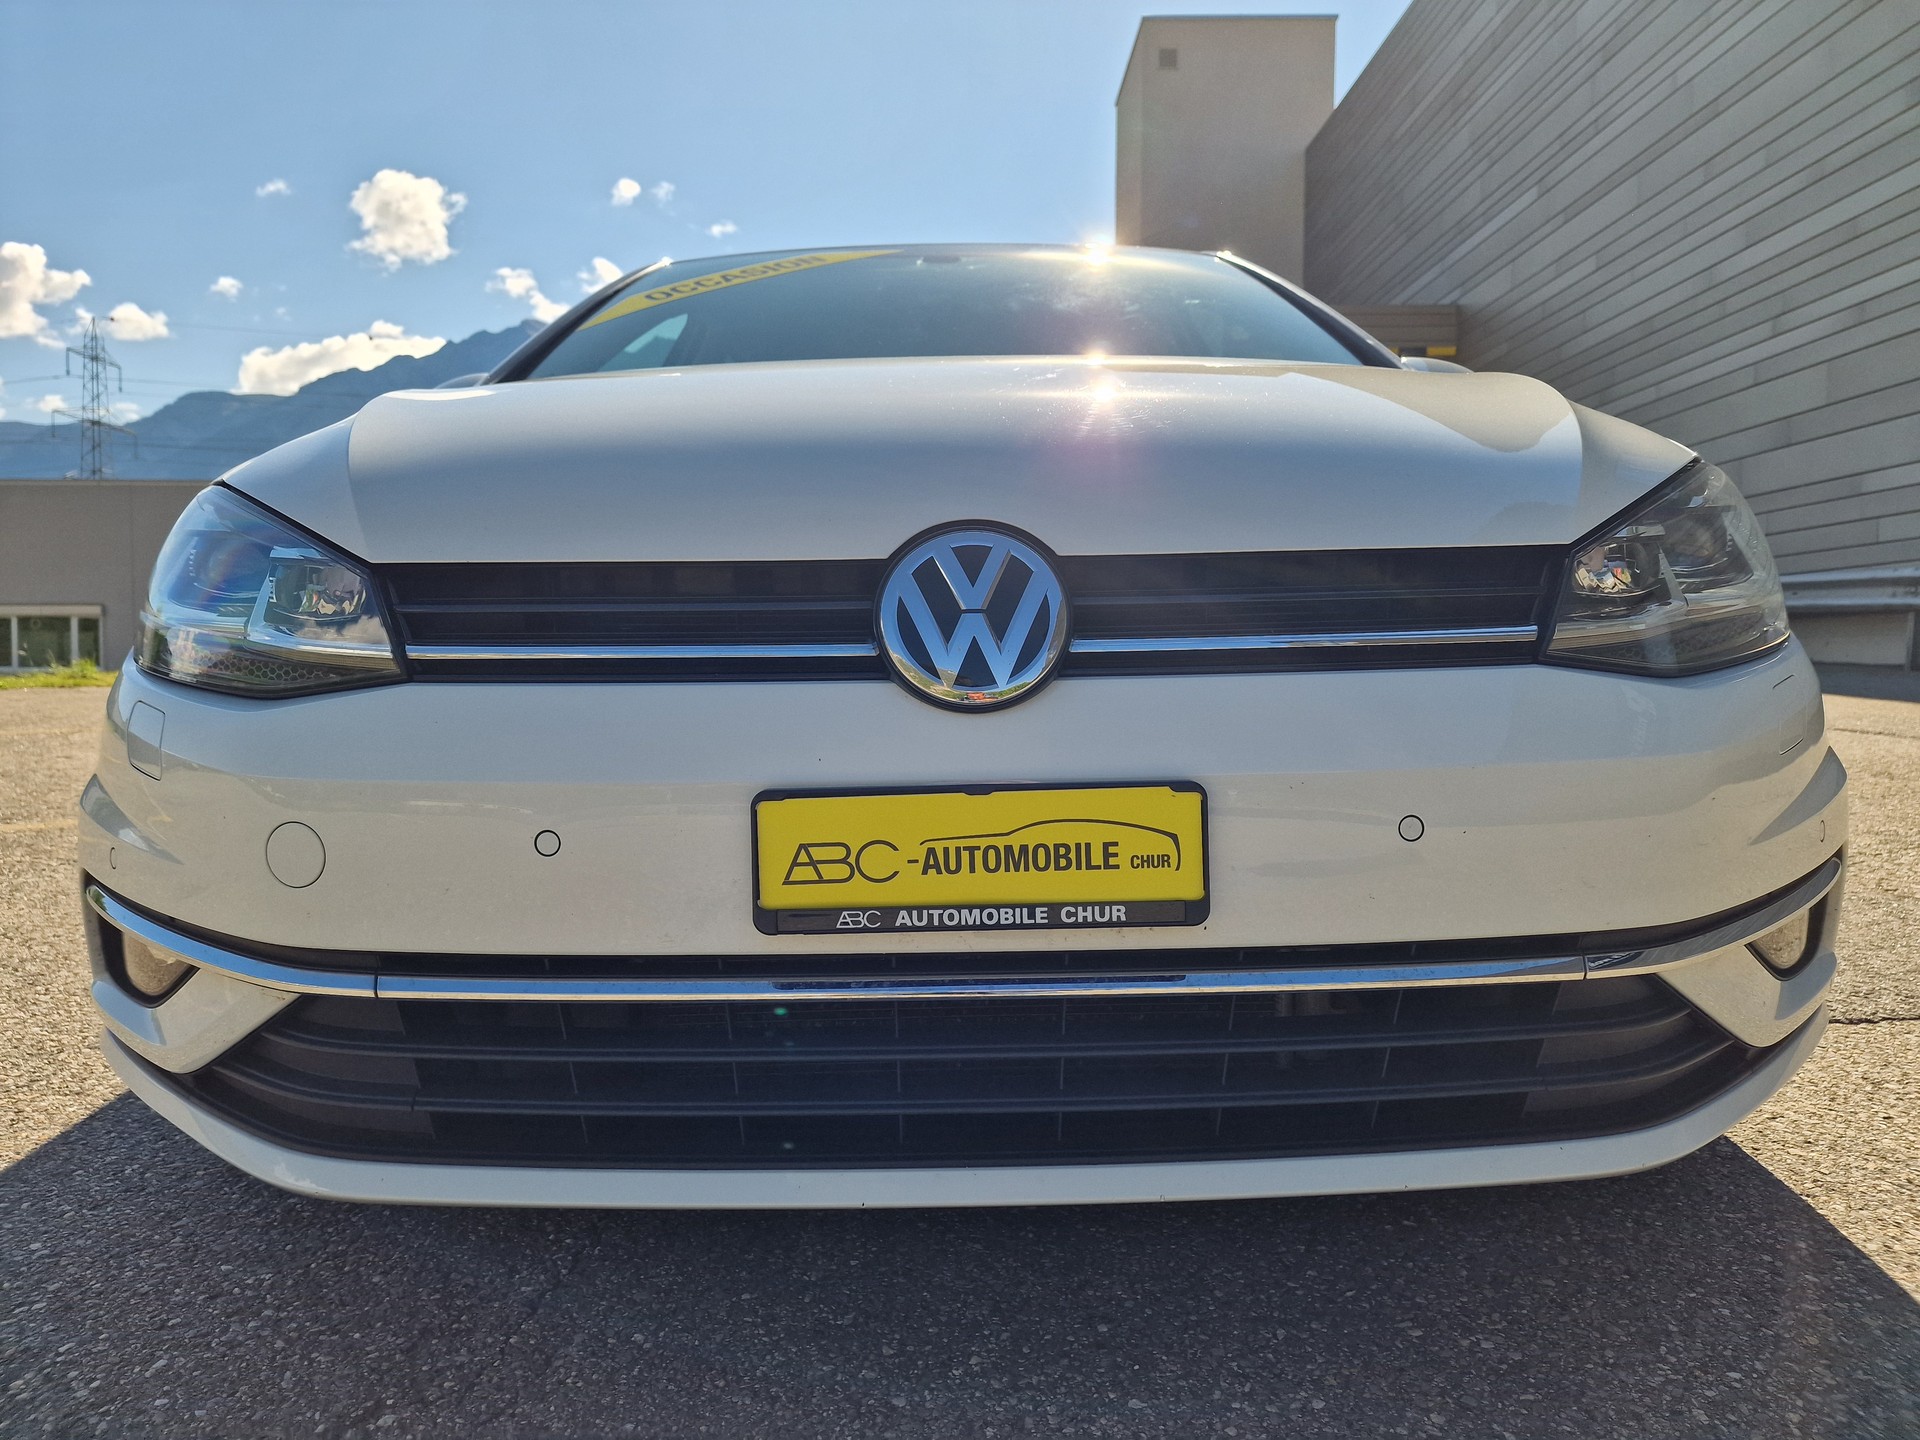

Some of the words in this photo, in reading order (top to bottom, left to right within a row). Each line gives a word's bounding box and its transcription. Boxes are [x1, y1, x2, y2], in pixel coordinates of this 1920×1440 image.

[645, 255, 825, 301] OCCASION
[884, 532, 1064, 701] VW
[782, 839, 900, 886] ABC
[1130, 854, 1172, 869] CHUR
[836, 910, 882, 929] ABC
[895, 907, 1049, 927] AUTOMOBILE
[1060, 905, 1127, 922] CHUR
